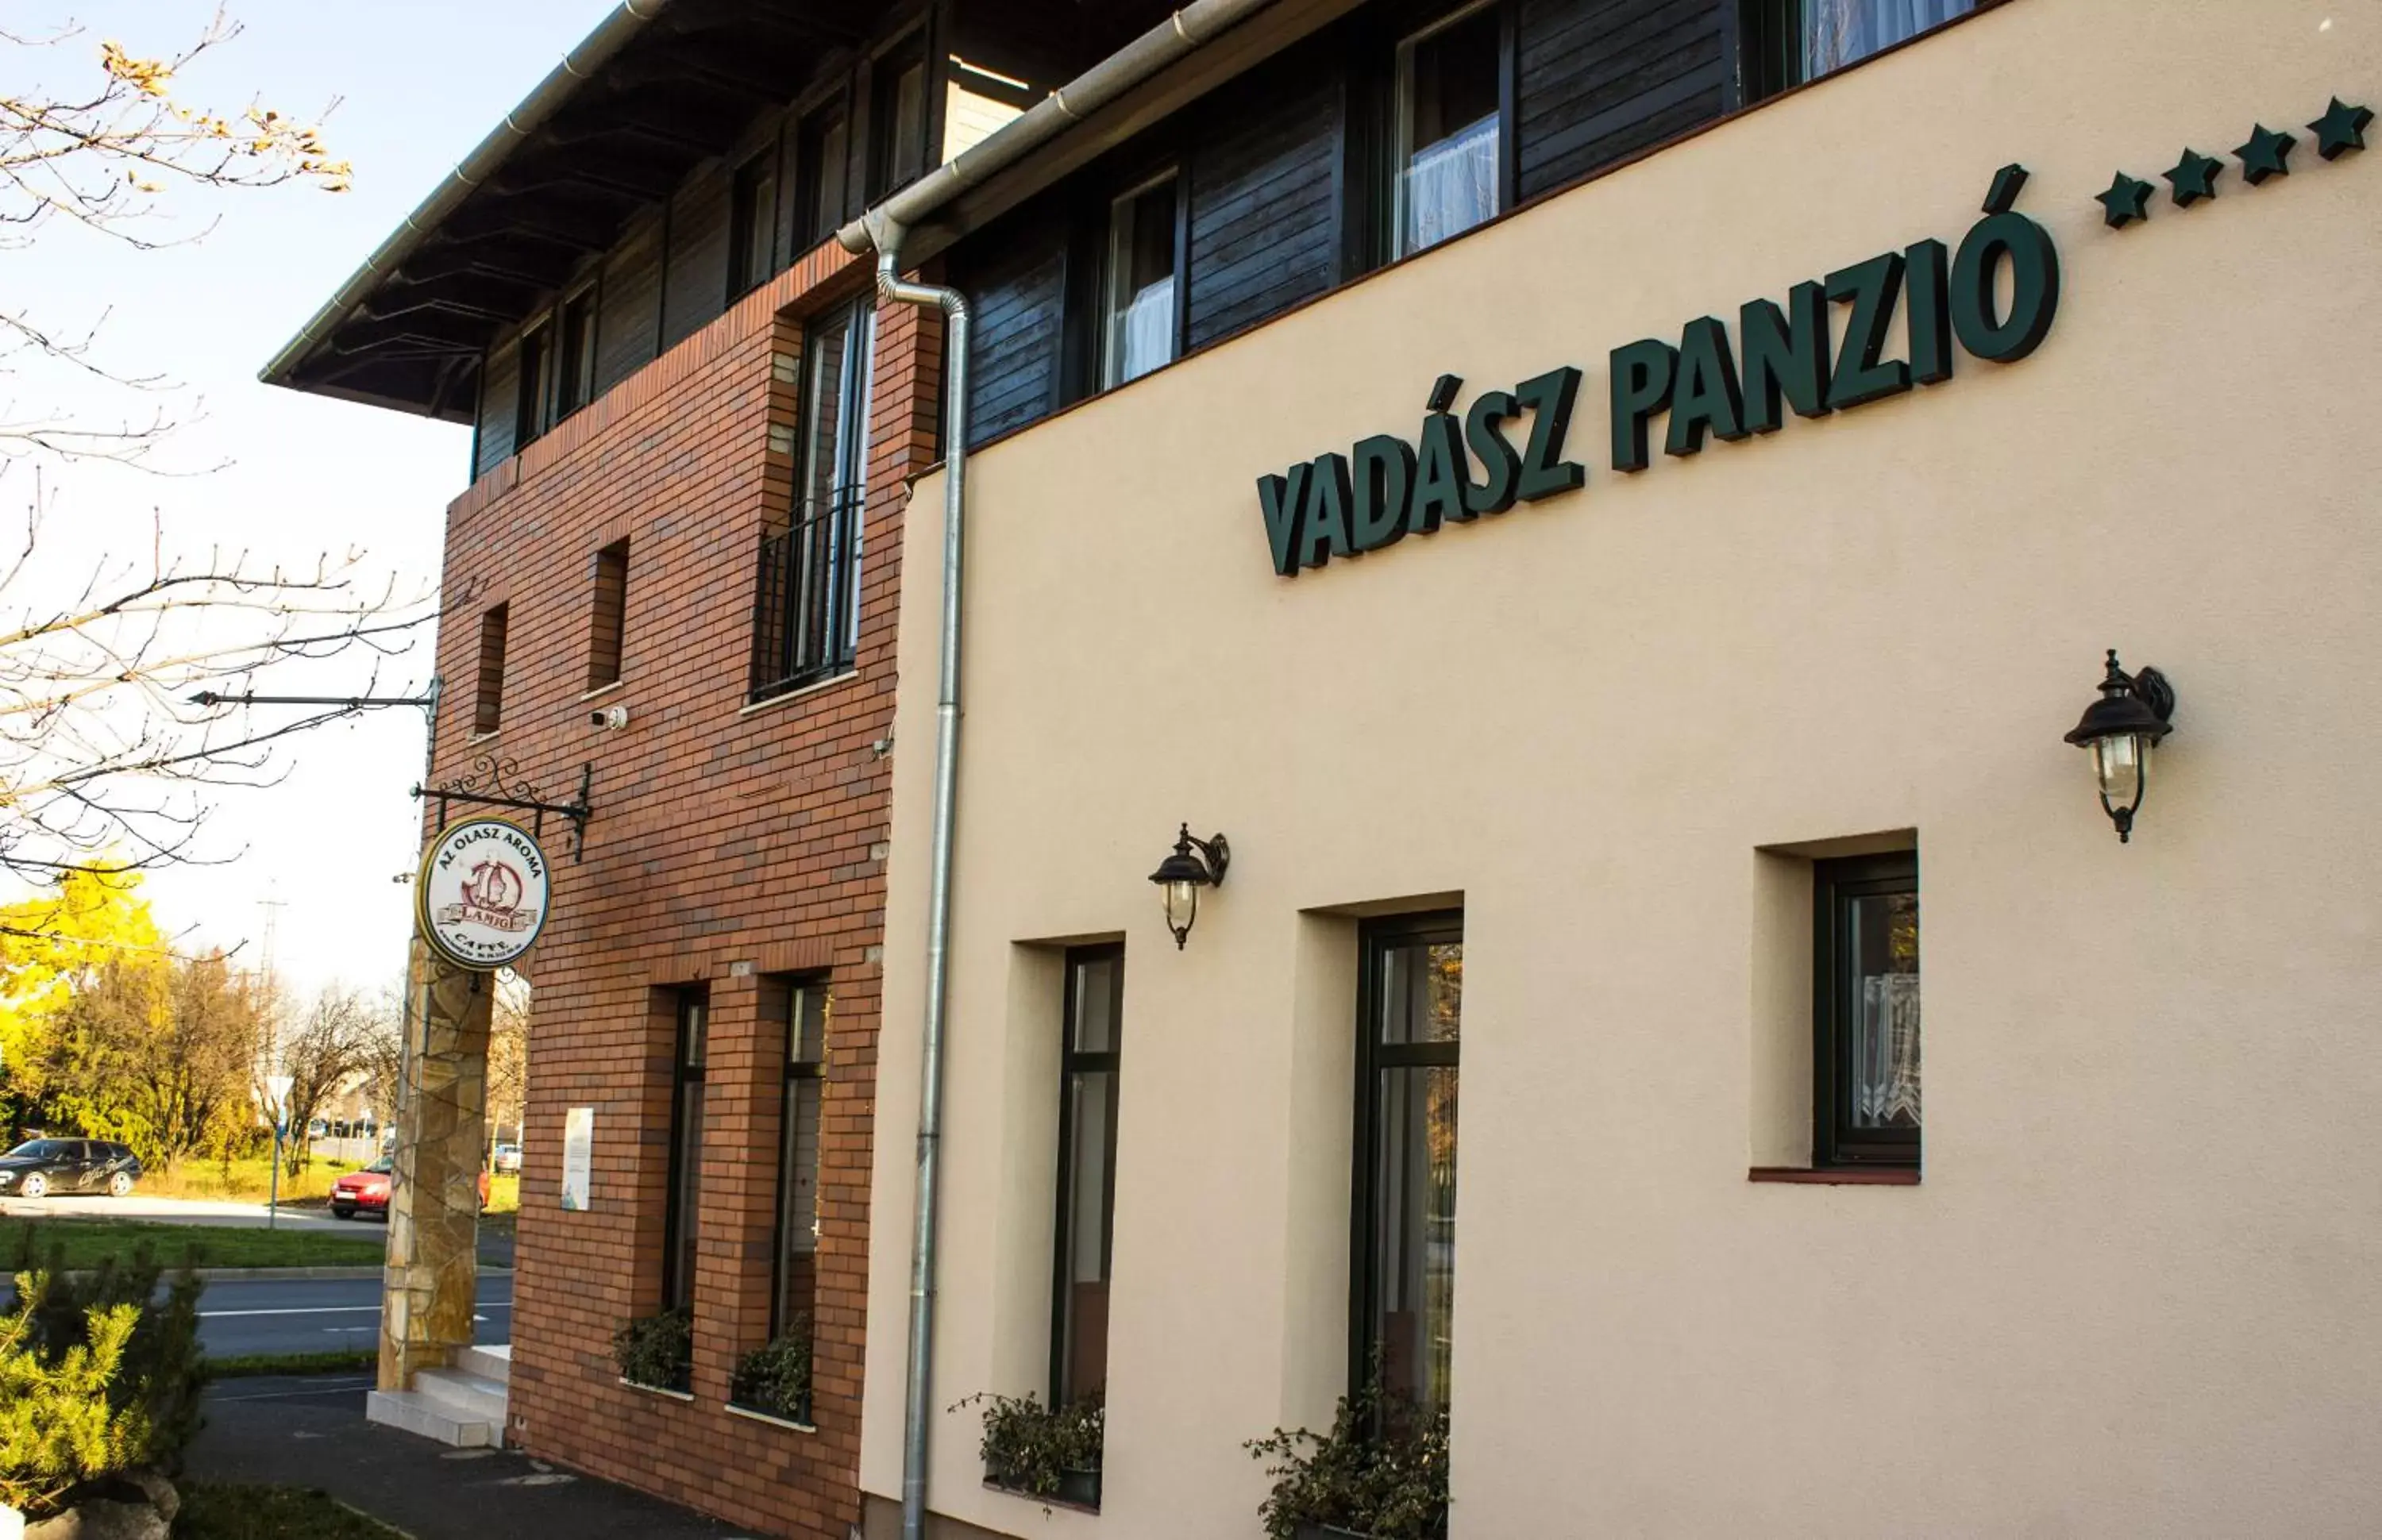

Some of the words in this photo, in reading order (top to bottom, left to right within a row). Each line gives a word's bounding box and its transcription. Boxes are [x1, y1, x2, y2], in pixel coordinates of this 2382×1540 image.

[1257, 364, 1585, 577] VADÁSZ
[1609, 163, 2060, 473] PANZIÓ
[439, 849, 456, 870] AZ
[454, 828, 499, 850] OLASZ
[503, 834, 542, 879] AROMA
